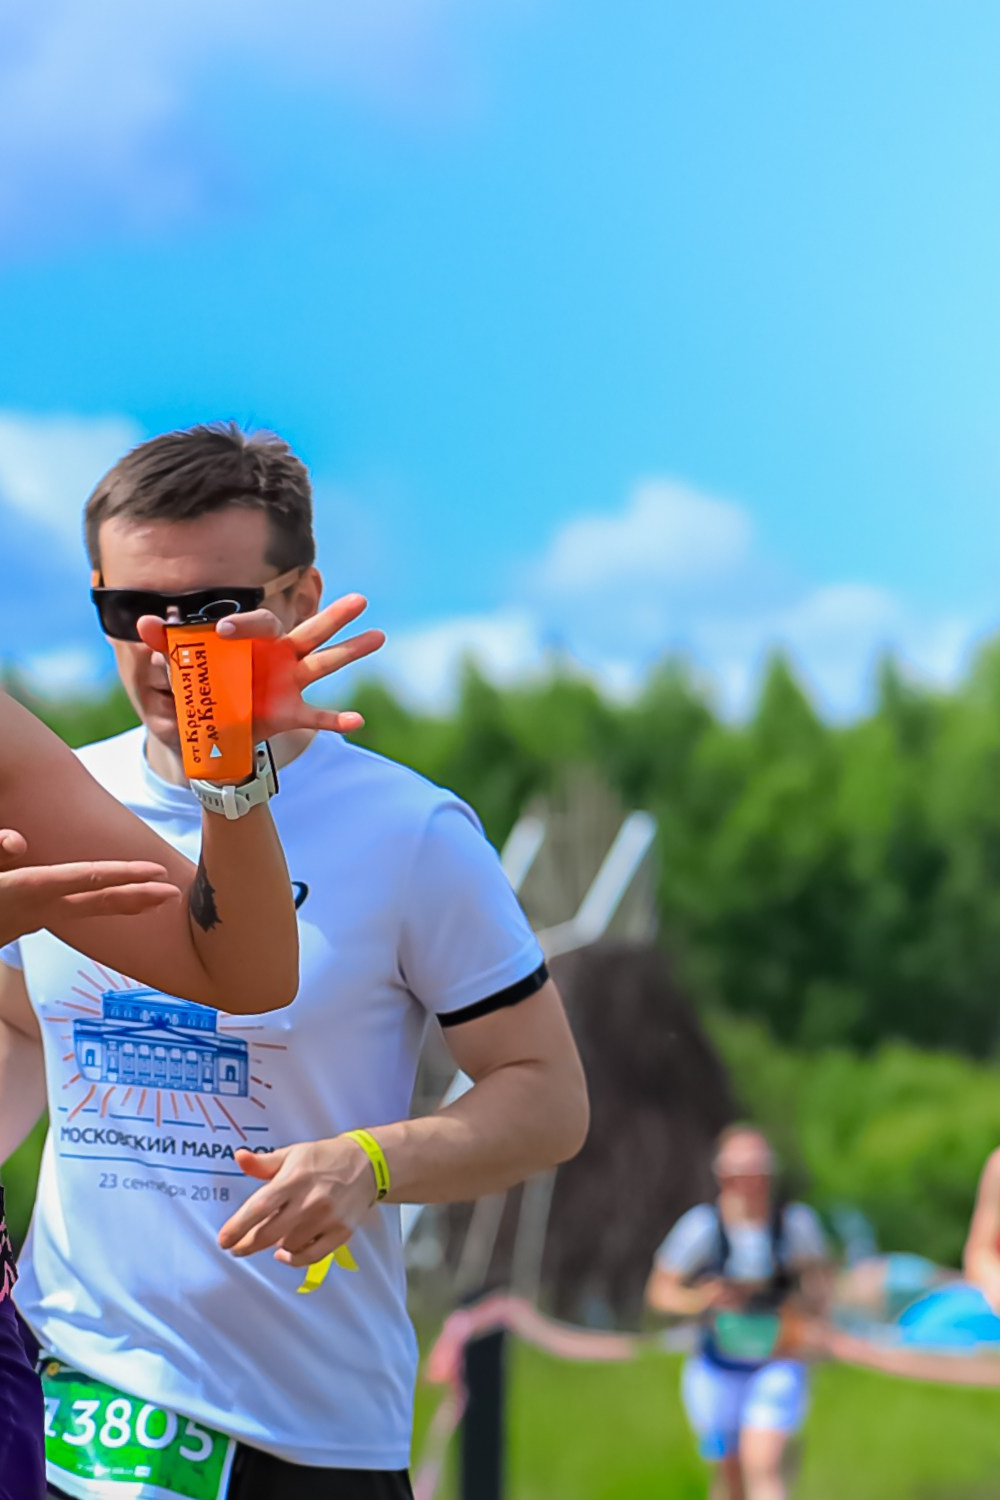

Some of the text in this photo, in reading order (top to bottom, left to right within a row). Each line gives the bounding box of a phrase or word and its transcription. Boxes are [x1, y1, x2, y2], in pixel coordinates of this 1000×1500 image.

[60, 1126, 276, 1161] МОСКОВСКИЙ МАРА
[98, 1173, 118, 1189] 23
[190, 1185, 230, 1202] 2018
[44, 1398, 213, 1462] 13805
